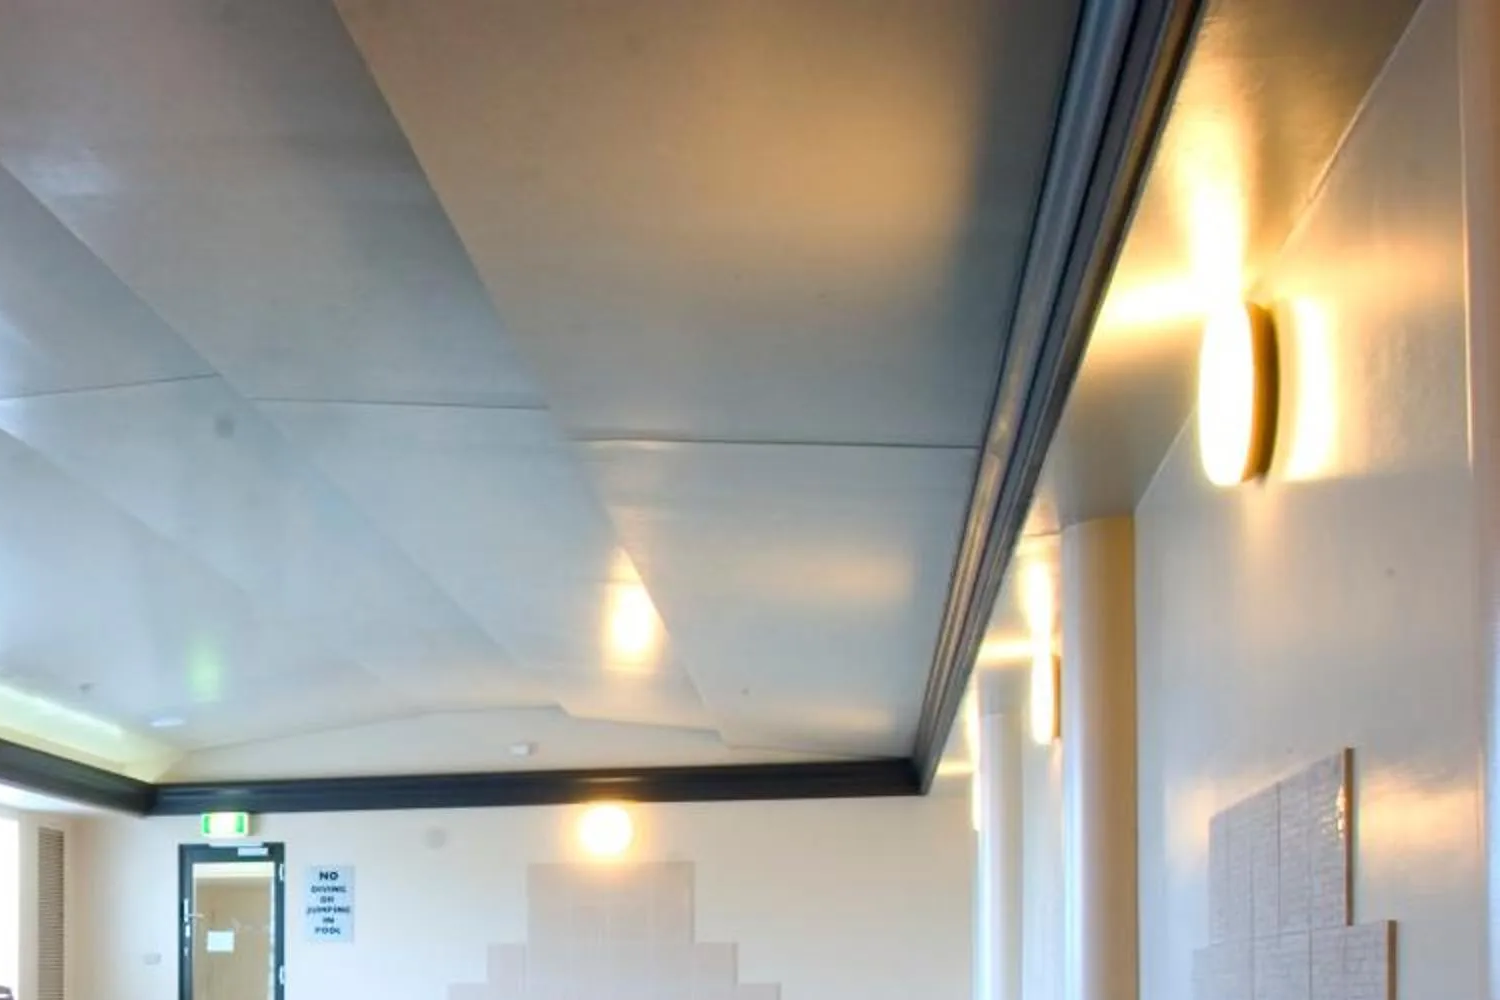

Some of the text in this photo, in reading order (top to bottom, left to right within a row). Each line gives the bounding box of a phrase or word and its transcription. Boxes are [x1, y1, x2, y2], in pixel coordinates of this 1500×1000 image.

[319, 871, 339, 881] NO
[311, 885, 347, 893] DIVING
[307, 906, 351, 914] JUMPING
[315, 927, 341, 935] POOL
